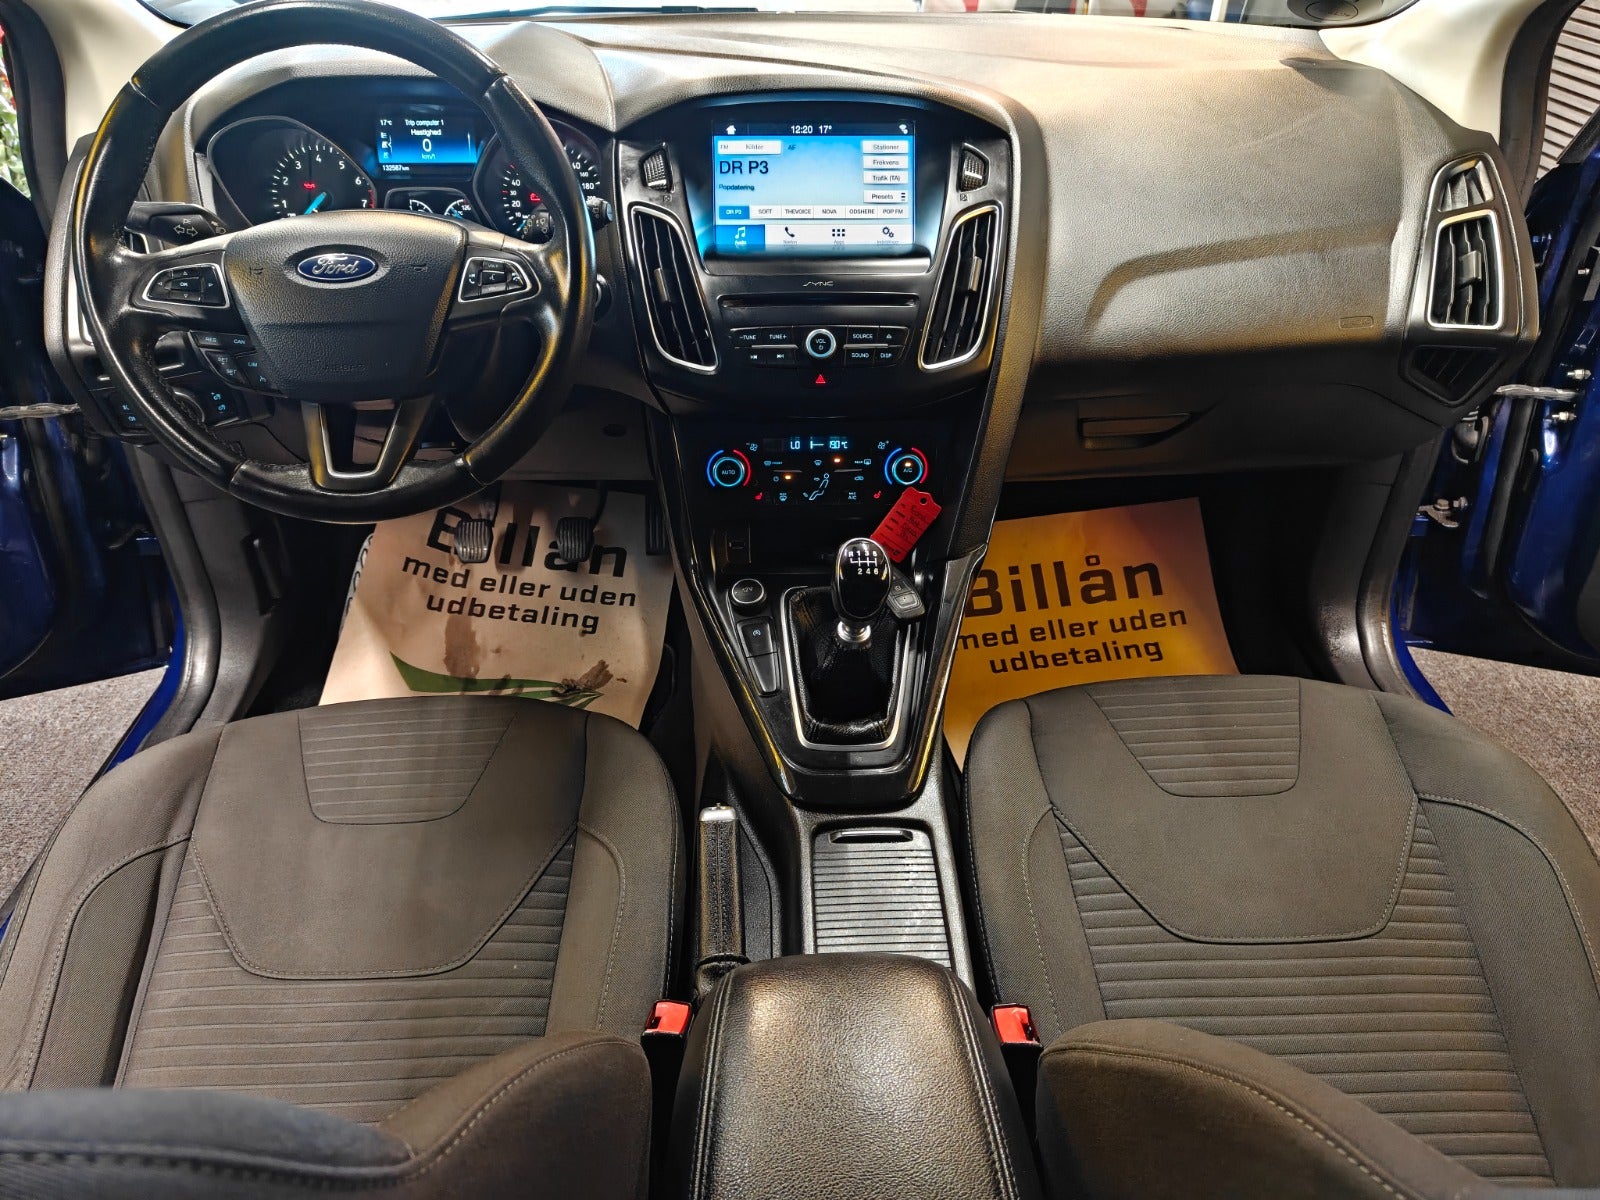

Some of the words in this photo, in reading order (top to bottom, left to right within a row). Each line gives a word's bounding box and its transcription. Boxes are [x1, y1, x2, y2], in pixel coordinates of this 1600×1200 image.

[416, 119, 440, 127] computer
[790, 124, 813, 134] 12:20
[818, 124, 832, 134] 17°
[422, 138, 432, 152] 0
[315, 154, 322, 163] 4
[295, 160, 302, 170] 3
[338, 160, 345, 170] 5
[719, 160, 743, 175] DR
[748, 160, 769, 175] P3
[282, 176, 289, 186] 2
[355, 176, 362, 186] 6
[511, 179, 521, 187] 40
[581, 182, 595, 190] 180
[281, 199, 287, 209] 1
[361, 199, 367, 209] 7
[511, 200, 521, 208] 20
[311, 254, 360, 275] Ford
[848, 550, 854, 558] R
[857, 567, 863, 575] 2
[865, 567, 871, 575] 4
[873, 567, 879, 575] 6
[402, 555, 470, 589] med
[479, 574, 551, 598] eller
[559, 584, 637, 607] uden
[965, 554, 1164, 618] Billån
[426, 594, 600, 635] udbetaling
[957, 624, 1019, 650] med
[1029, 618, 1099, 642] eller
[1109, 608, 1188, 633] uden
[989, 641, 1164, 674] udbetaling
